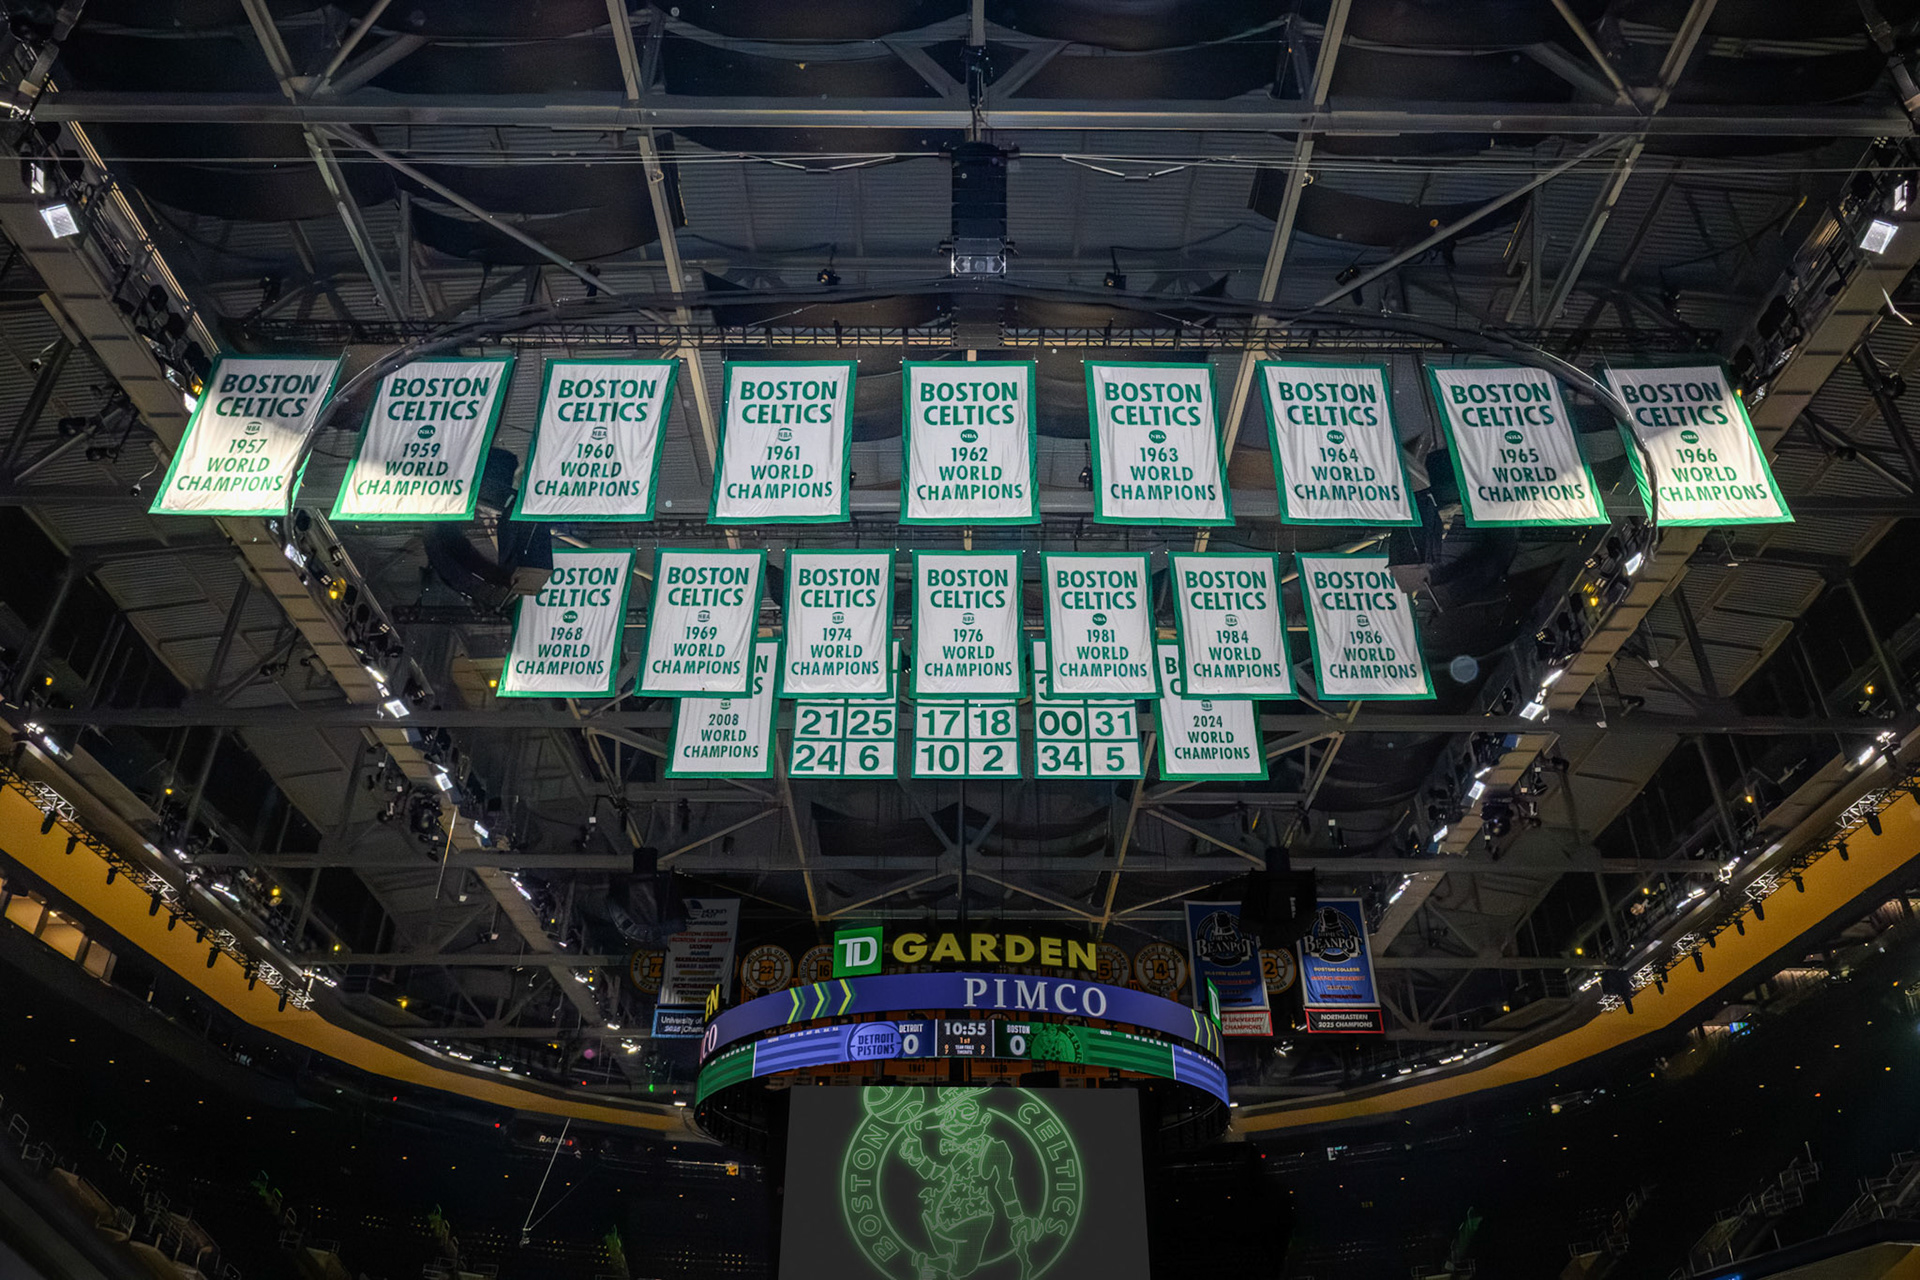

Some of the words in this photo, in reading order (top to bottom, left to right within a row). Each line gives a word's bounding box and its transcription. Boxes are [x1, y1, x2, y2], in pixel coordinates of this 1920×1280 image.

[219, 373, 322, 395] BOSTON
[389, 377, 490, 398] BOSTON
[558, 379, 657, 399] BOSTON
[740, 381, 837, 401] BOSTON
[920, 382, 1019, 402] BOSTON
[1104, 382, 1202, 403] BOSTON
[1278, 381, 1377, 404] BOSTON
[1450, 382, 1552, 404] BOSTON
[1621, 382, 1724, 404] BOSTON
[216, 396, 308, 419] CELTICS
[387, 400, 479, 421] CELTICS
[558, 401, 648, 422] CELTICS
[742, 404, 832, 424] CELTICS
[924, 404, 1014, 426] CELTICS
[1110, 405, 1201, 426] CELTICS
[1287, 405, 1378, 426] CELTICS
[1462, 405, 1555, 428] CELTICS
[1634, 404, 1728, 427] CELTICS
[229, 439, 268, 453] 1957
[402, 442, 441, 458] 1959
[577, 443, 615, 459] 1960
[767, 445, 800, 460] 1961
[951, 447, 988, 462] 1962
[1140, 447, 1179, 462] 1963
[1319, 447, 1358, 463] 1964
[208, 457, 269, 472] WORLD
[1499, 448, 1539, 464] 1965
[1676, 448, 1717, 463] 1966
[384, 460, 449, 477] WORLD
[561, 461, 622, 478] WORLD
[751, 464, 813, 480] WORLD
[939, 465, 1002, 481] WORLD
[1130, 465, 1193, 481] WORLD
[1311, 466, 1375, 482] WORLD
[1492, 466, 1557, 484] WORLD
[1671, 467, 1737, 482] WORLD
[177, 476, 283, 491] CHAMPIONS
[357, 479, 464, 496] CHAMPIONS
[534, 480, 640, 497] CHAMPIONS
[727, 481, 832, 499] CHAMPIONS
[917, 483, 1023, 501] CHAMPIONS
[1111, 483, 1216, 501] CHAMPIONS
[1660, 484, 1767, 501] CHAMPIONS
[1293, 484, 1400, 502] CHAMPIONS
[1477, 483, 1585, 503] CHAMPIONS
[549, 566, 619, 586] OSTON
[667, 566, 750, 585] BOSTON
[798, 568, 880, 586] BOSTON
[928, 569, 1008, 587] BOSTON
[1057, 570, 1138, 589] BOSTON
[1185, 571, 1267, 589] BOSTON
[1313, 570, 1397, 590] BOSTON
[534, 587, 611, 607] CELTICS
[668, 587, 744, 607] CELTICS
[801, 589, 876, 608] CELTICS
[930, 589, 1005, 609] CELTICS
[1061, 591, 1137, 610] CELTICS
[1190, 591, 1266, 610] CELTICS
[1320, 592, 1397, 611] CELTICS
[551, 627, 583, 641] 1968
[686, 626, 717, 640] 1969
[823, 628, 852, 641] 1974
[954, 629, 983, 642] 1976
[1087, 629, 1115, 643] 1981
[1216, 630, 1249, 644] 1984
[1349, 630, 1382, 645] 1986
[538, 643, 590, 659] WORLD
[674, 643, 725, 658] WORLD
[810, 644, 863, 658] WORLD
[942, 645, 994, 660] WORLD
[1077, 646, 1129, 661] WORLD
[1208, 647, 1261, 661] WORLD
[1343, 647, 1395, 662] WORLD
[516, 659, 604, 675] CHAMPIONS
[652, 660, 740, 675] CHAMPIONS
[791, 660, 879, 676] CHAMPIONS
[924, 661, 1012, 677] CHAMPIONS
[1059, 662, 1147, 677] CHAMPIONS
[1193, 663, 1281, 678] CHAMPIONS
[1329, 663, 1417, 679] CHAMPIONS
[708, 713, 739, 726] 2008
[800, 709, 839, 736] 21
[849, 709, 892, 736] 25
[922, 709, 960, 736] 17
[973, 709, 1011, 736] 18
[1039, 710, 1083, 736] 00
[1095, 711, 1131, 737] 31
[1193, 715, 1222, 728] 2024
[701, 729, 747, 742] WORLD
[1187, 731, 1234, 744] WORLD
[683, 745, 759, 758] CHAMPIONS
[793, 744, 838, 772] 24
[859, 745, 880, 771] 6
[921, 744, 959, 772] 10
[982, 745, 1004, 772] 2
[1041, 745, 1084, 772] 34
[1106, 747, 1125, 772] 5
[1174, 747, 1250, 760] CHAMPIONS
[838, 937, 878, 967] TD
[892, 933, 1097, 971] GARDEN
[1196, 938, 1252, 957] BEANPOT
[1303, 935, 1362, 955] BEANPOT
[760, 966, 773, 974] 22
[819, 966, 829, 977] 16
[1100, 963, 1110, 976] 5
[1156, 963, 1166, 976] 4
[1264, 962, 1275, 974] 2
[964, 978, 1106, 1016] PIMCO
[899, 1024, 923, 1032] DETROIT
[944, 1022, 986, 1035] 10:55
[1007, 1025, 1030, 1034] BOSTON
[858, 1033, 894, 1045] DETROIT
[903, 1034, 919, 1055] 0
[1010, 1035, 1026, 1056] 0
[858, 1044, 894, 1056] PISTONS
[1018, 1103, 1077, 1237] CELTICS
[851, 1124, 899, 1262] BOSTON
